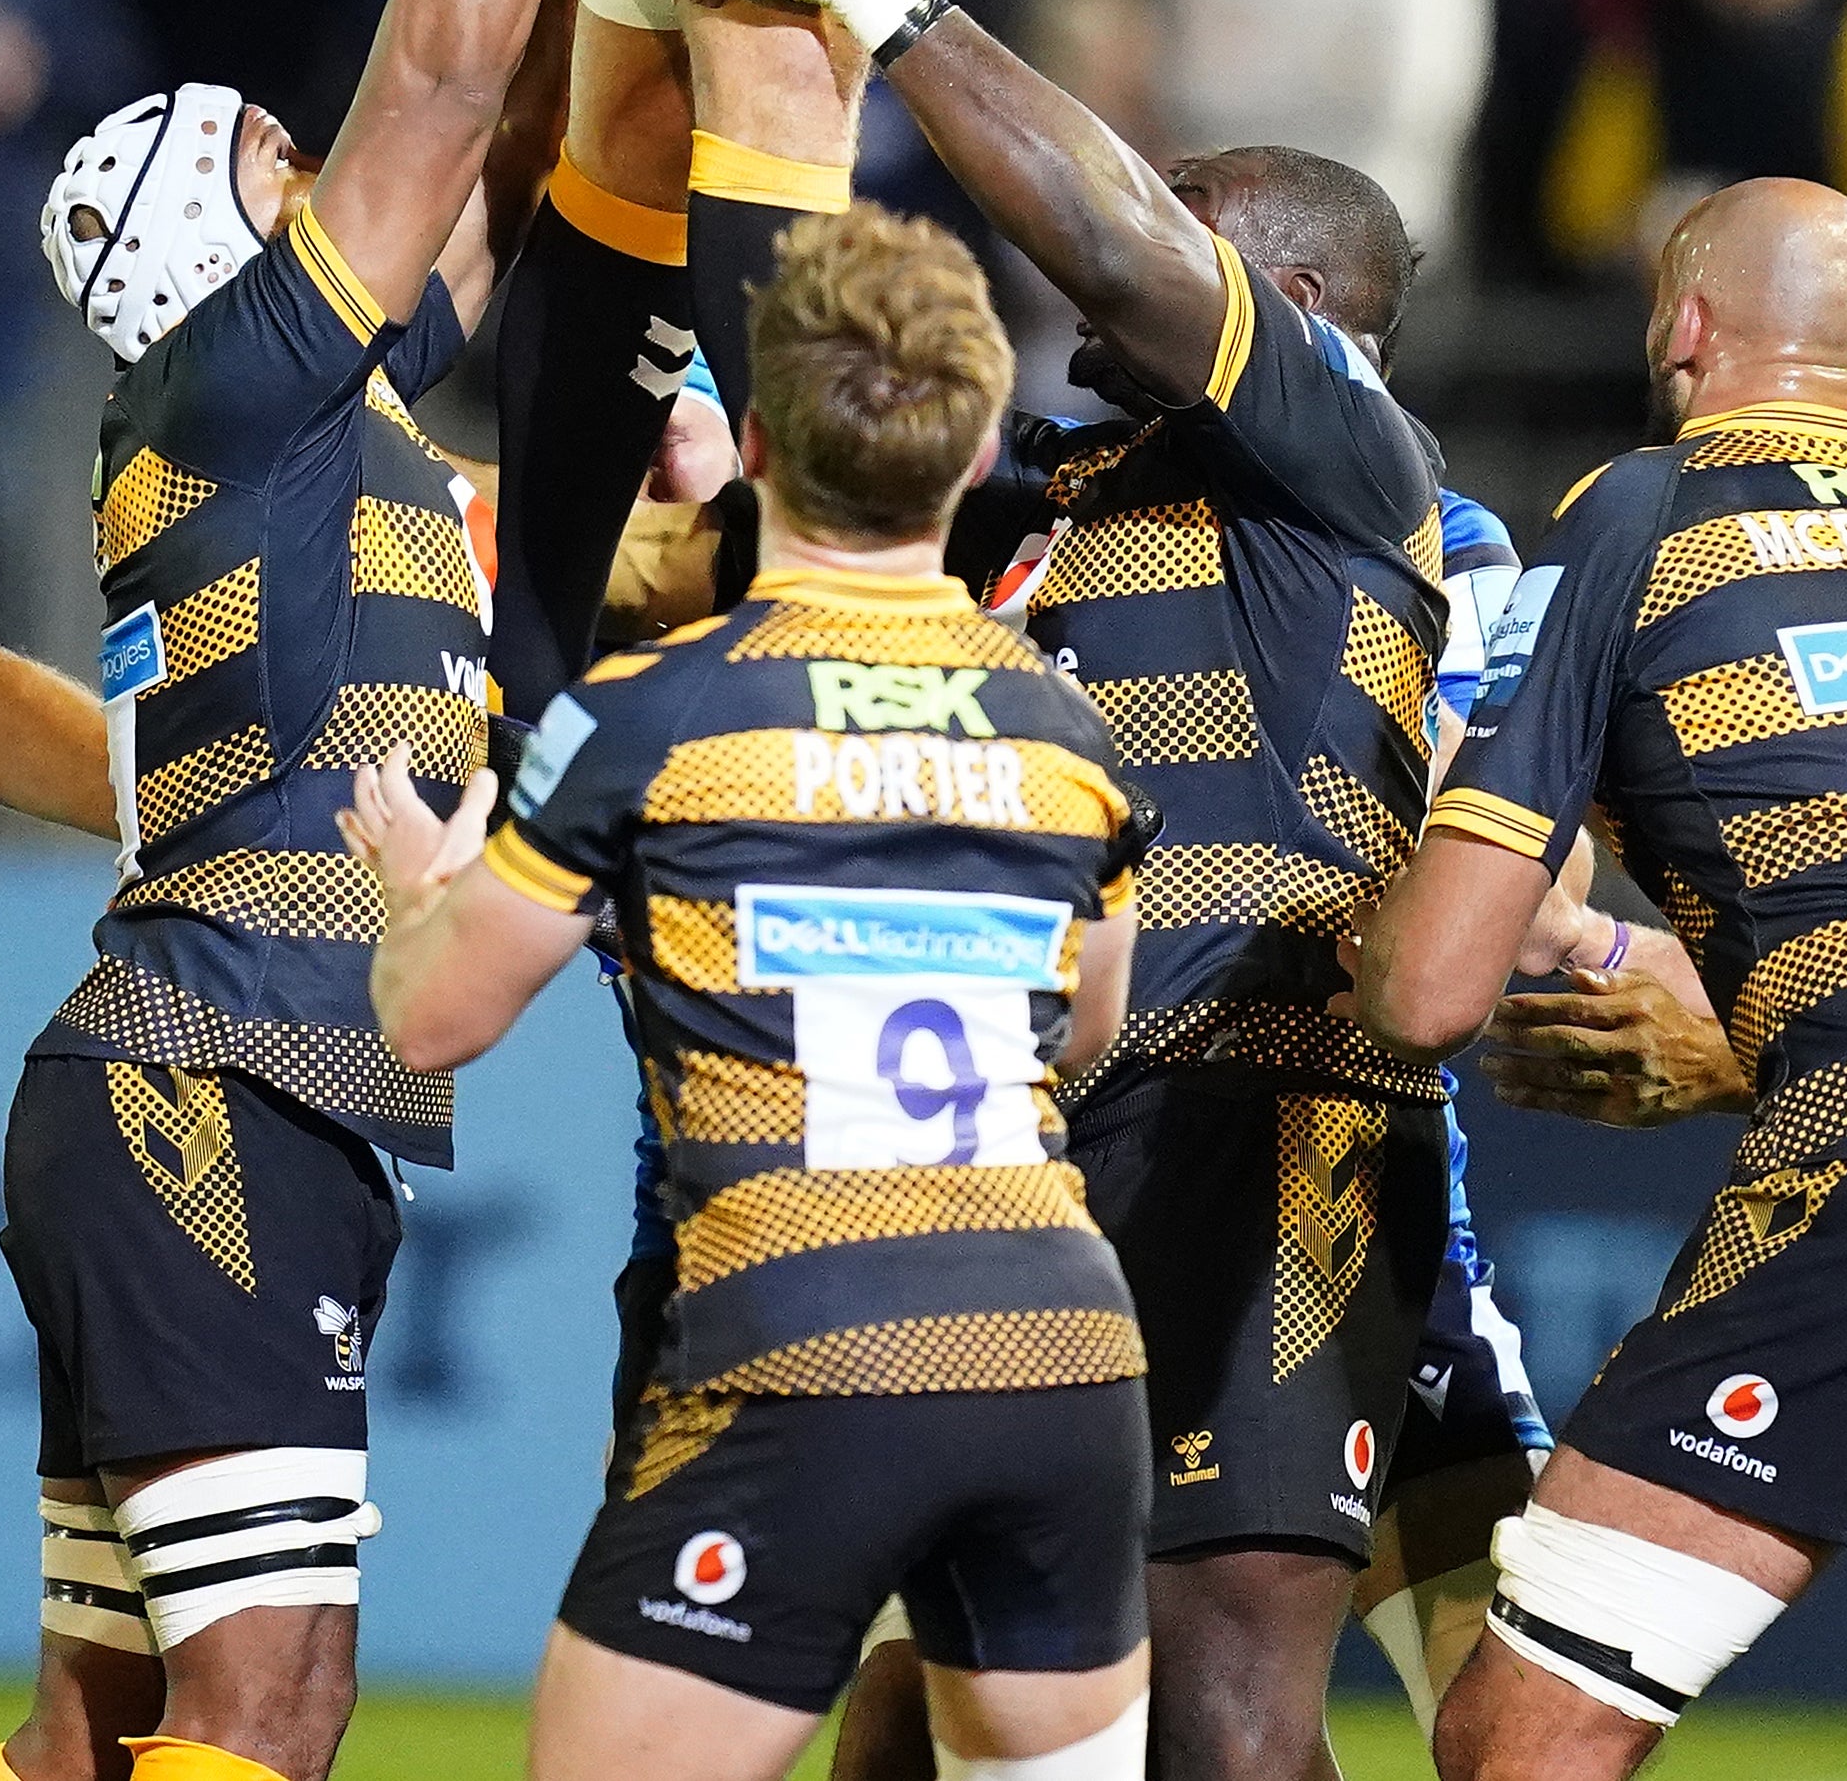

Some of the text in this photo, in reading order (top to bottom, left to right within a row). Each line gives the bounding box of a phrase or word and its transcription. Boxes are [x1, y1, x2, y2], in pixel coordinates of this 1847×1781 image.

[806, 660, 999, 739] RSK
[793, 731, 1030, 826] PORTER
[757, 915, 869, 956] DELL
[876, 997, 988, 1165] 9
[1170, 1463, 1220, 1487] hummel
[1669, 1428, 1778, 1484] vodafone
[638, 1595, 753, 1643] vodafone
